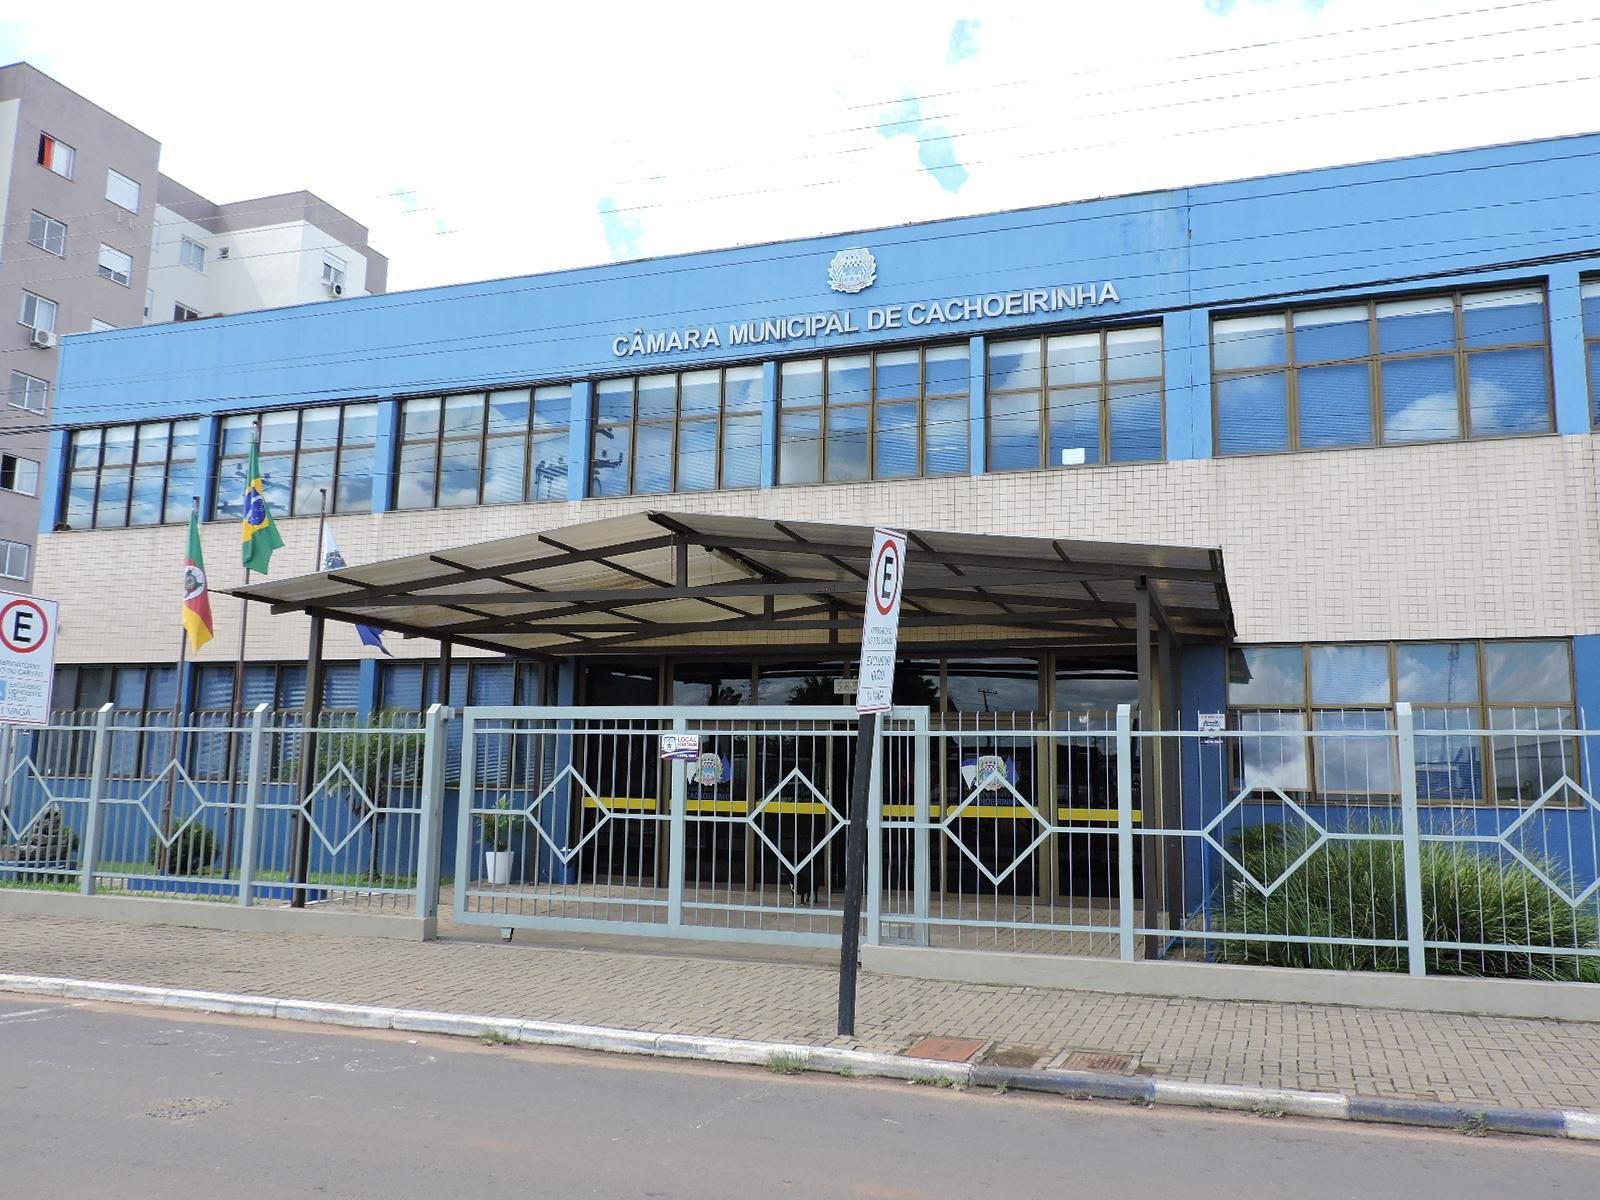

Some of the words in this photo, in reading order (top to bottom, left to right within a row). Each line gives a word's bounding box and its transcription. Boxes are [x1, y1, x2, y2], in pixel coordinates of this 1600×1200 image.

[612, 328, 721, 358] CÂMARA
[729, 312, 859, 344] MUNICIPAL
[868, 306, 902, 330] DE
[907, 281, 1120, 326] CACHOEIRINHA
[881, 556, 894, 599] E
[13, 611, 33, 643] E
